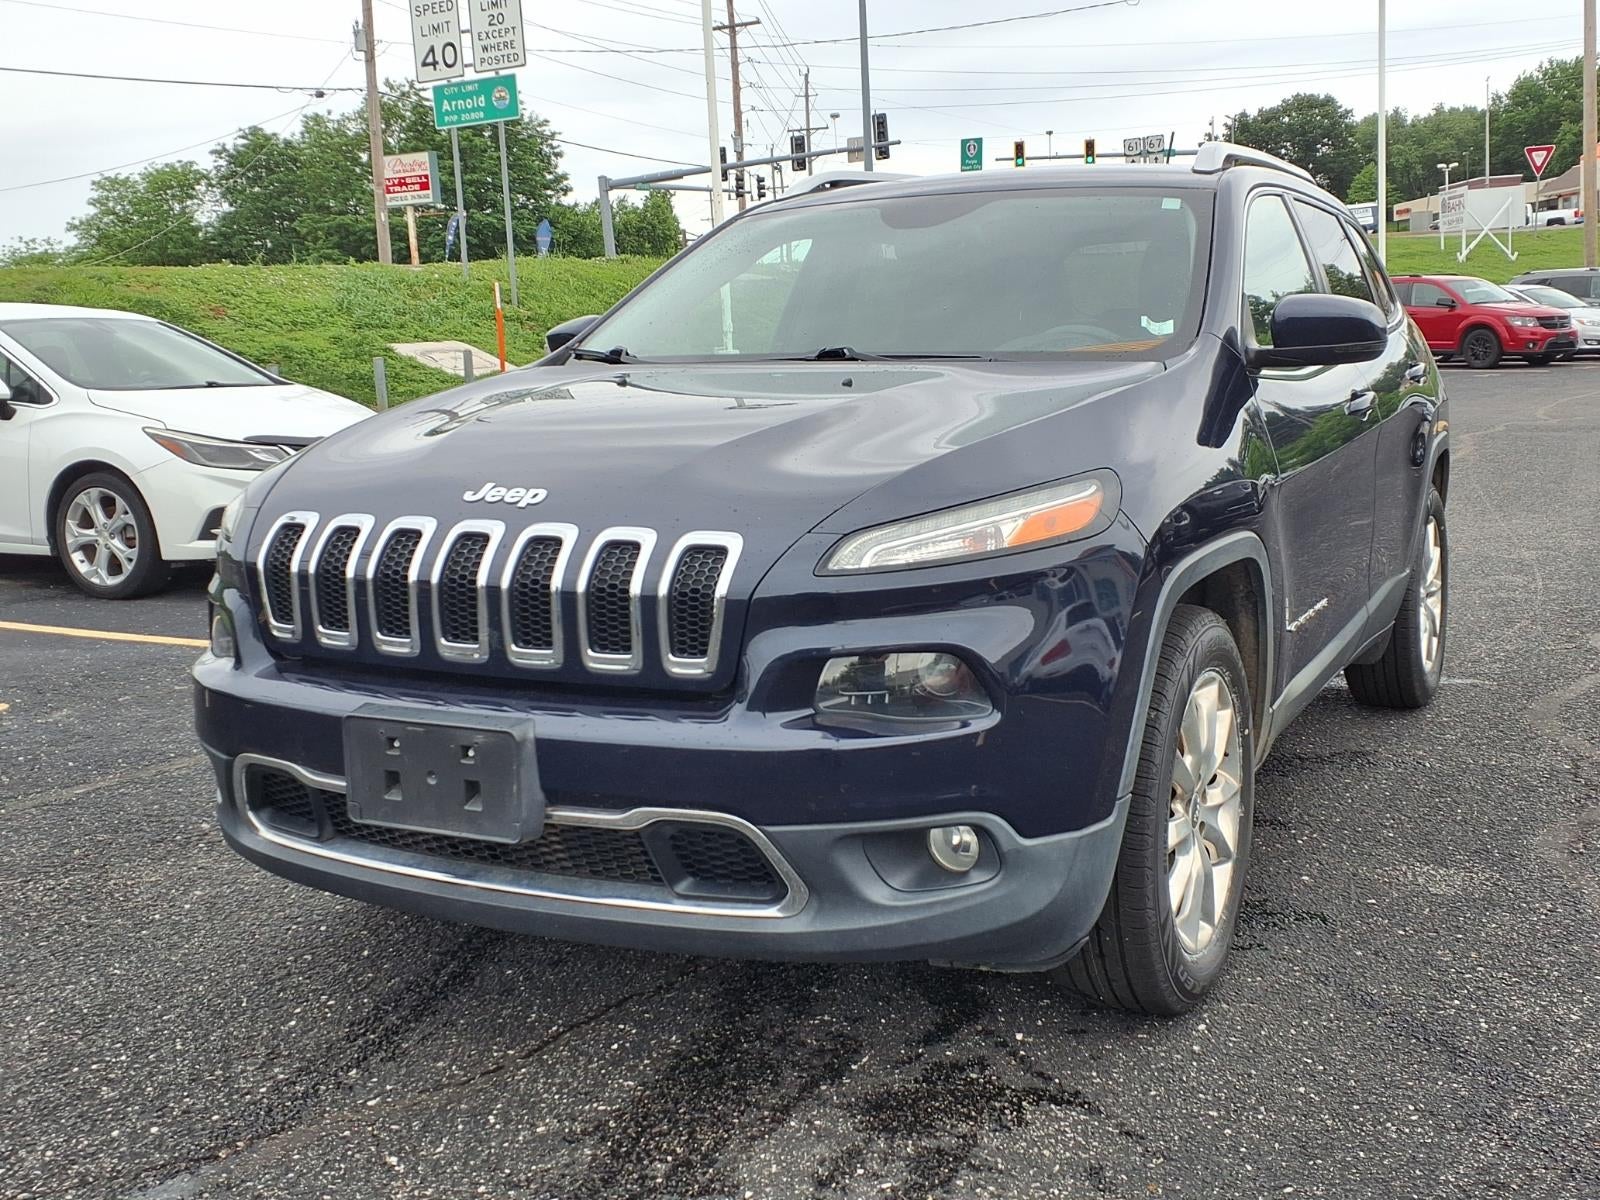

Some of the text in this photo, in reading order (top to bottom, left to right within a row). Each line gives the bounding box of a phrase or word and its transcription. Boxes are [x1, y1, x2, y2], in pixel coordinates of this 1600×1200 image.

[415, 0, 454, 17] SPEED
[480, 0, 508, 12] LIMIT
[488, 12, 505, 27] 20
[420, 21, 451, 37] LIMIT
[477, 26, 517, 41] EXCEPT
[481, 40, 516, 54] WHERE
[421, 41, 458, 71] 40
[480, 52, 520, 67] POSTED
[444, 83, 479, 95] CITY LIMIT
[442, 94, 486, 112] Arnold
[1127, 142, 1138, 151] 61
[1148, 138, 1162, 149] 67
[386, 175, 428, 186] UY SELL
[388, 184, 421, 193] TRADE
[462, 482, 548, 509] Jeep
